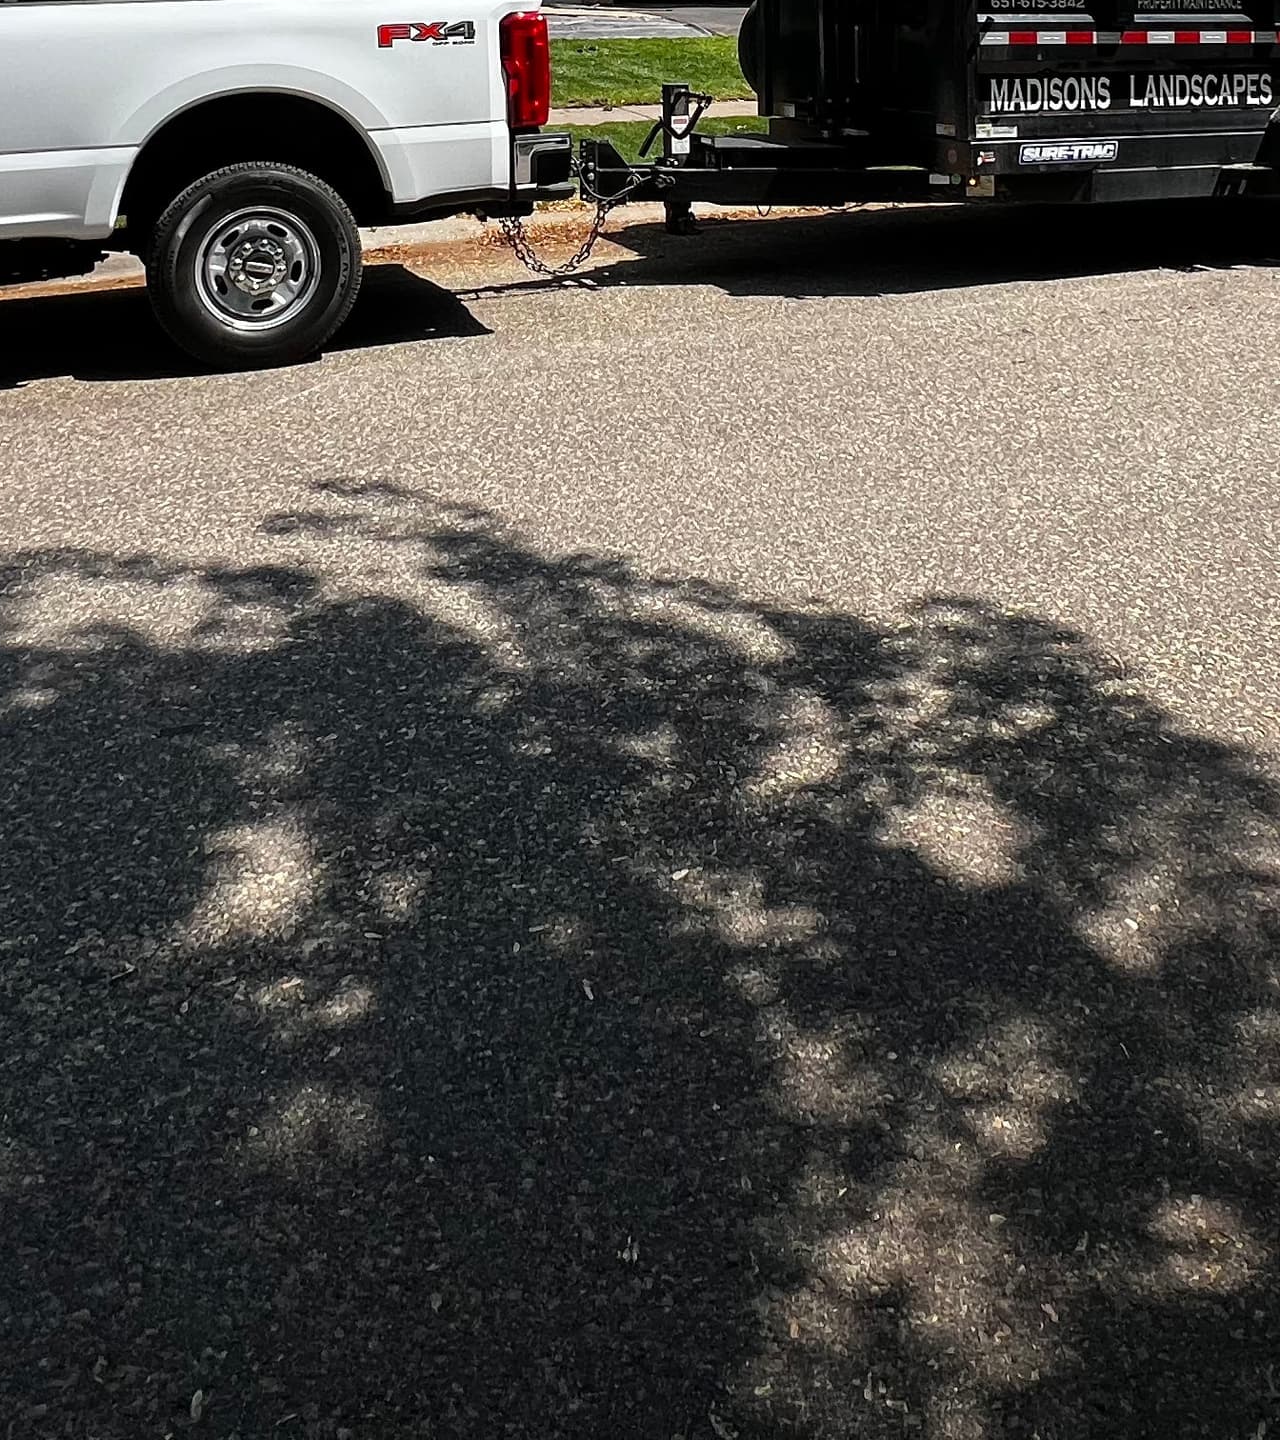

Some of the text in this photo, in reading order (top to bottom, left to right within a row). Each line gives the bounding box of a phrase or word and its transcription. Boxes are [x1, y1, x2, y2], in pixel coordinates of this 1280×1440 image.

[377, 20, 476, 48] FX4
[989, 73, 1273, 111] MADISONS LANDSCAPES
[1021, 144, 1116, 162] SURE-TRAC
